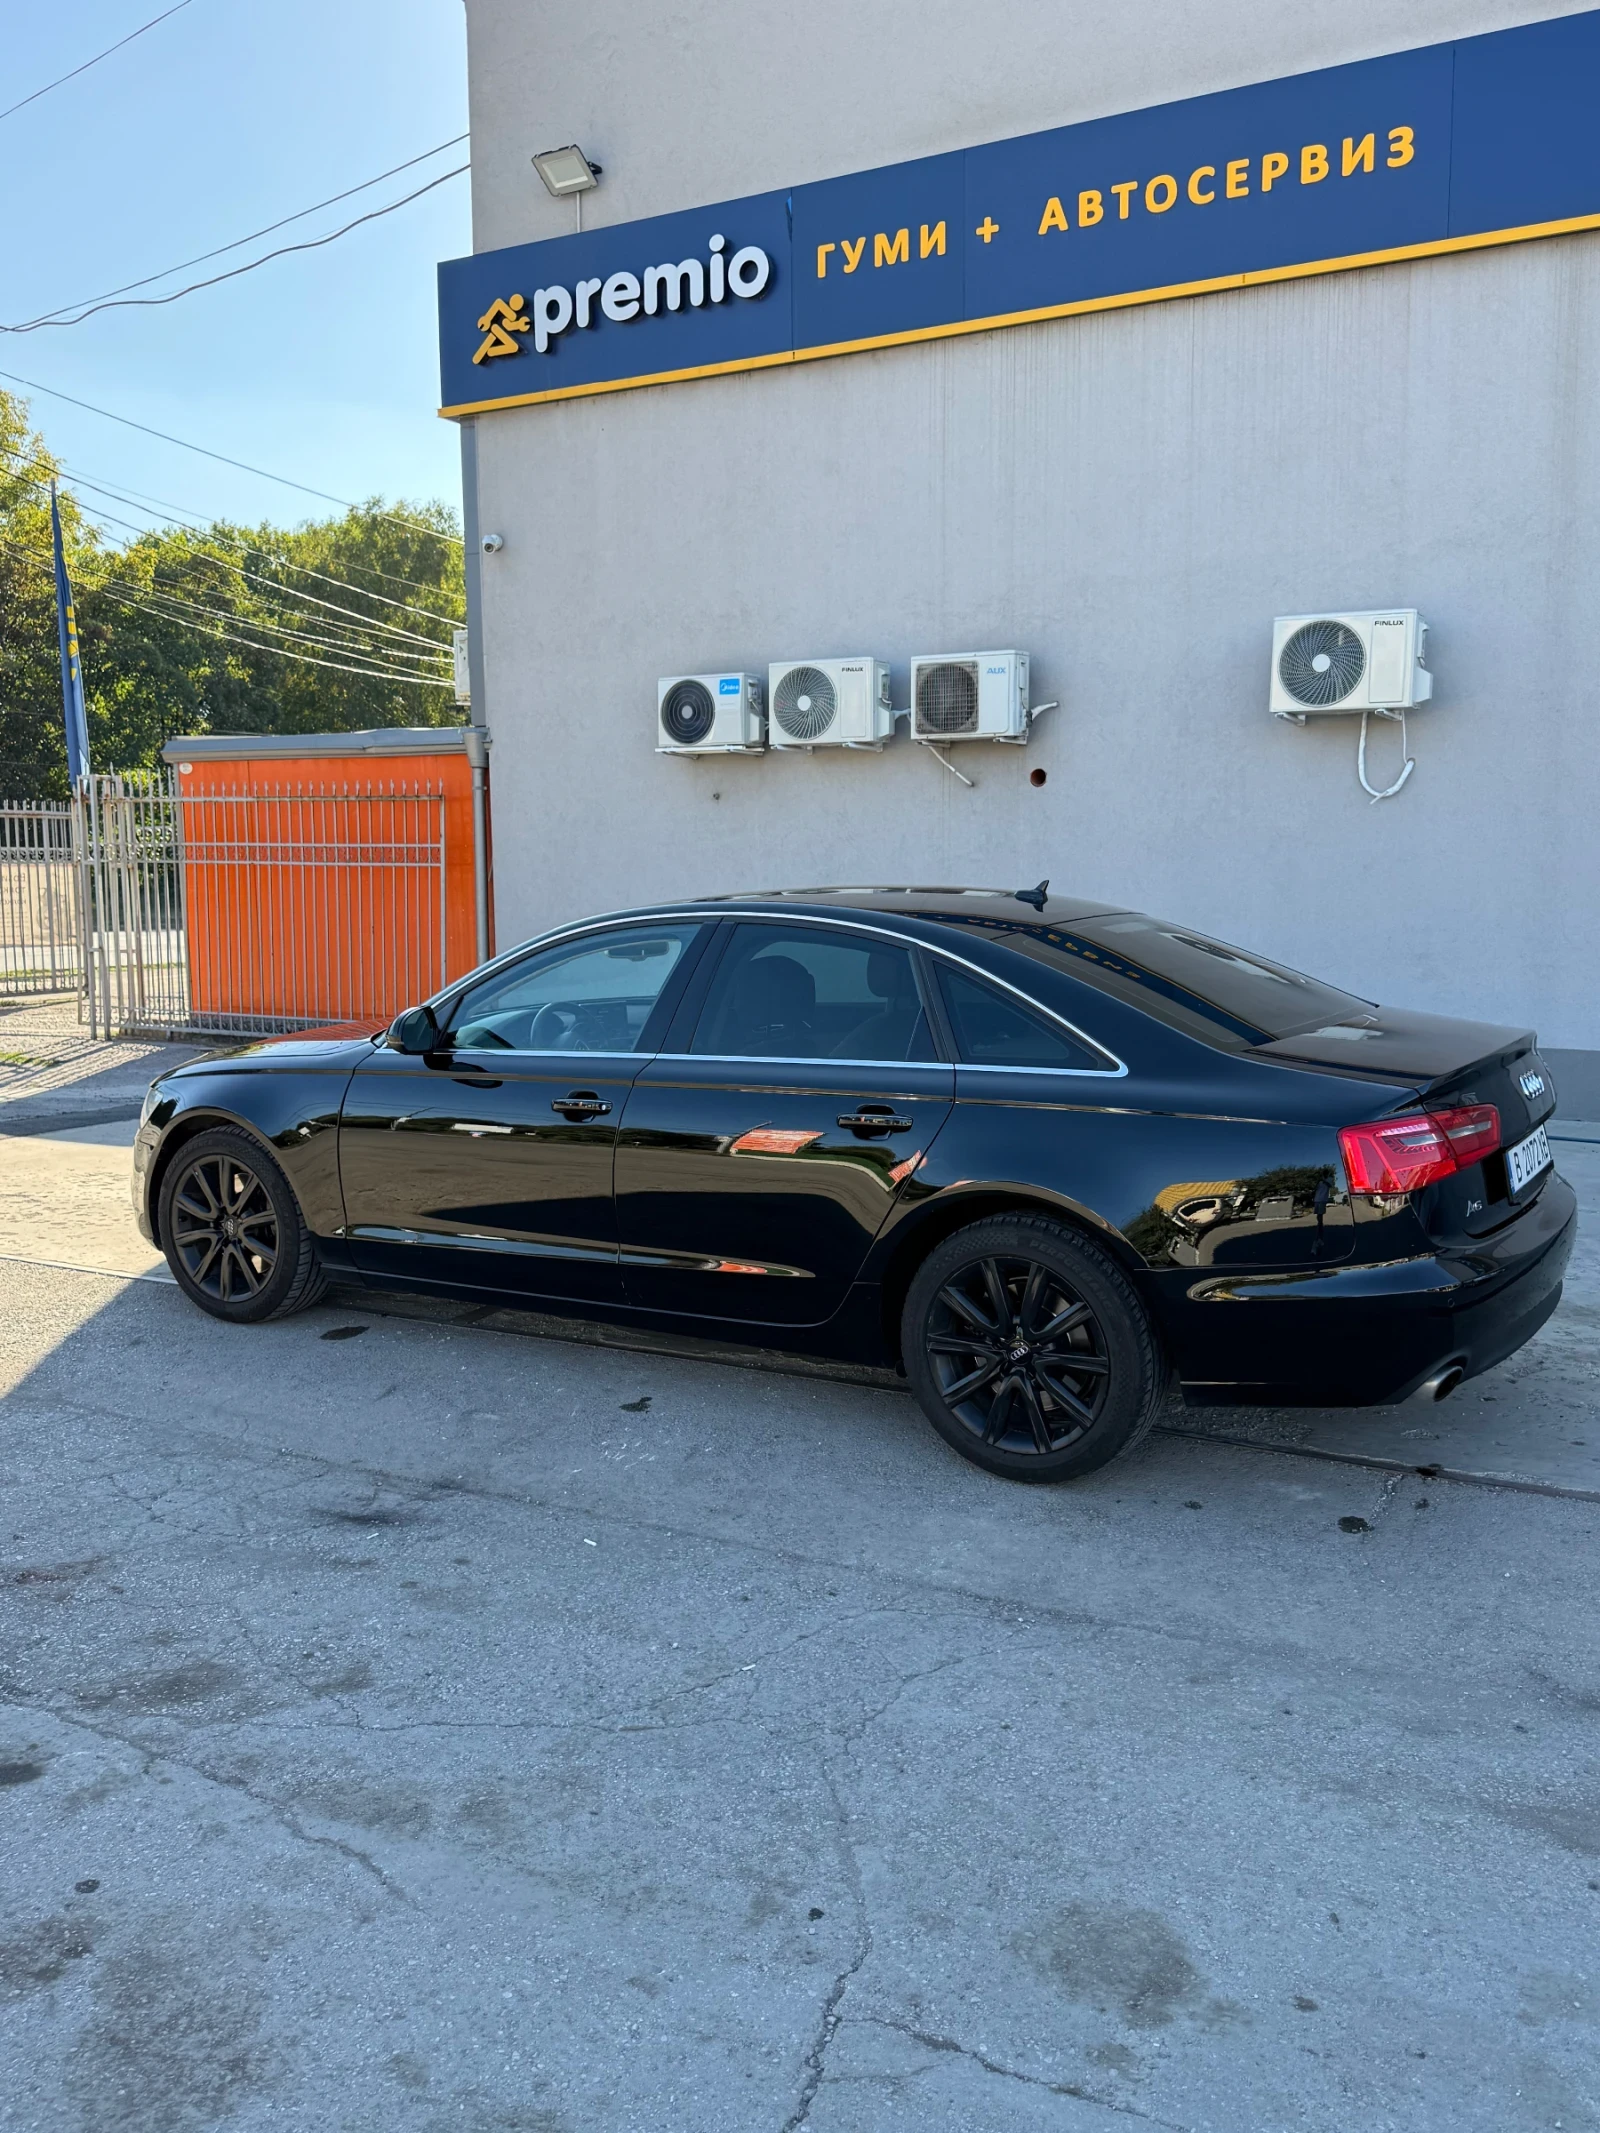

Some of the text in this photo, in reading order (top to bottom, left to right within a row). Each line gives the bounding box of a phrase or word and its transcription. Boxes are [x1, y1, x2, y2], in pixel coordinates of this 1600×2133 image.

[817, 126, 1415, 278] ГУМИ + АВТОСЕРВИЗ
[534, 233, 771, 353] premio
[1513, 1152, 1523, 1183] B
[1522, 1137, 1541, 1176] 2072
[1466, 1199, 1483, 1217] A6
